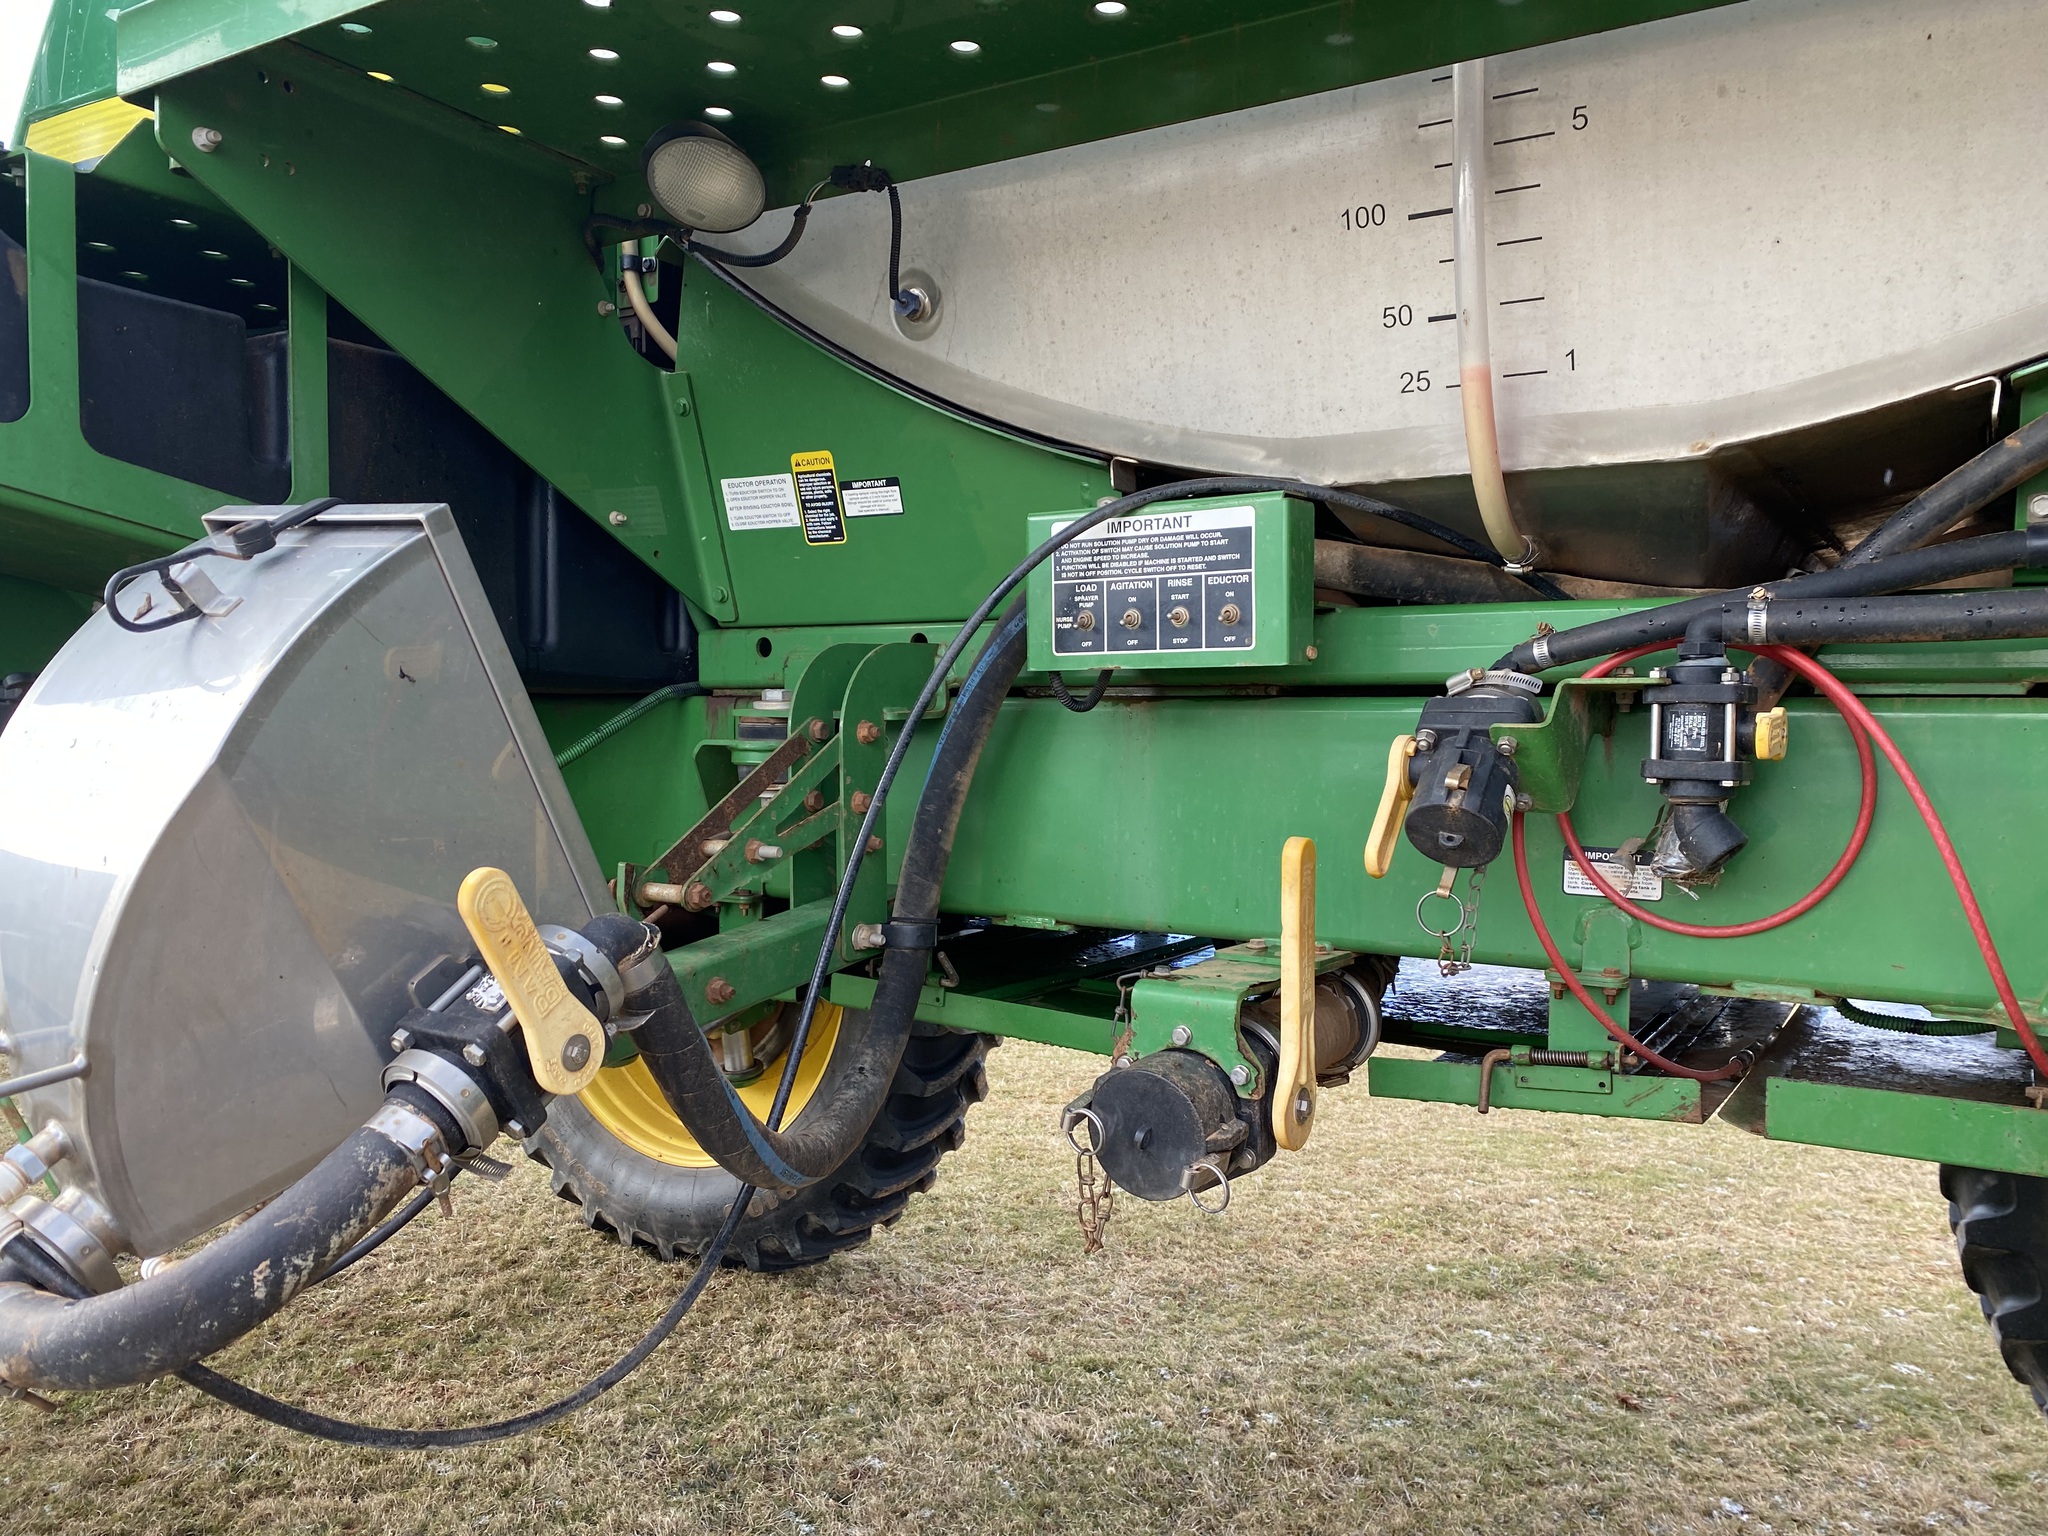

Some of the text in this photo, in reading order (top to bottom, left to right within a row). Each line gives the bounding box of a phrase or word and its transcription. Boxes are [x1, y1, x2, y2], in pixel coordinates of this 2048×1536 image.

[1572, 105, 1588, 131] 5
[1341, 203, 1386, 230] 100
[1383, 304, 1412, 328] 50
[1565, 349, 1575, 371] 1
[1400, 370, 1431, 394] 25
[801, 457, 830, 466] CAUTION
[727, 478, 787, 489] EDUCTOR OPERATION
[851, 479, 886, 489] IMPORTANT
[1107, 515, 1192, 534] IMPORTANT
[1061, 548, 1091, 556] ACTIVATION
[1110, 580, 1153, 591] AGITATION
[1168, 578, 1193, 588] RINSE
[1208, 575, 1249, 585] EDUCTOR
[1075, 584, 1097, 592] LOAD
